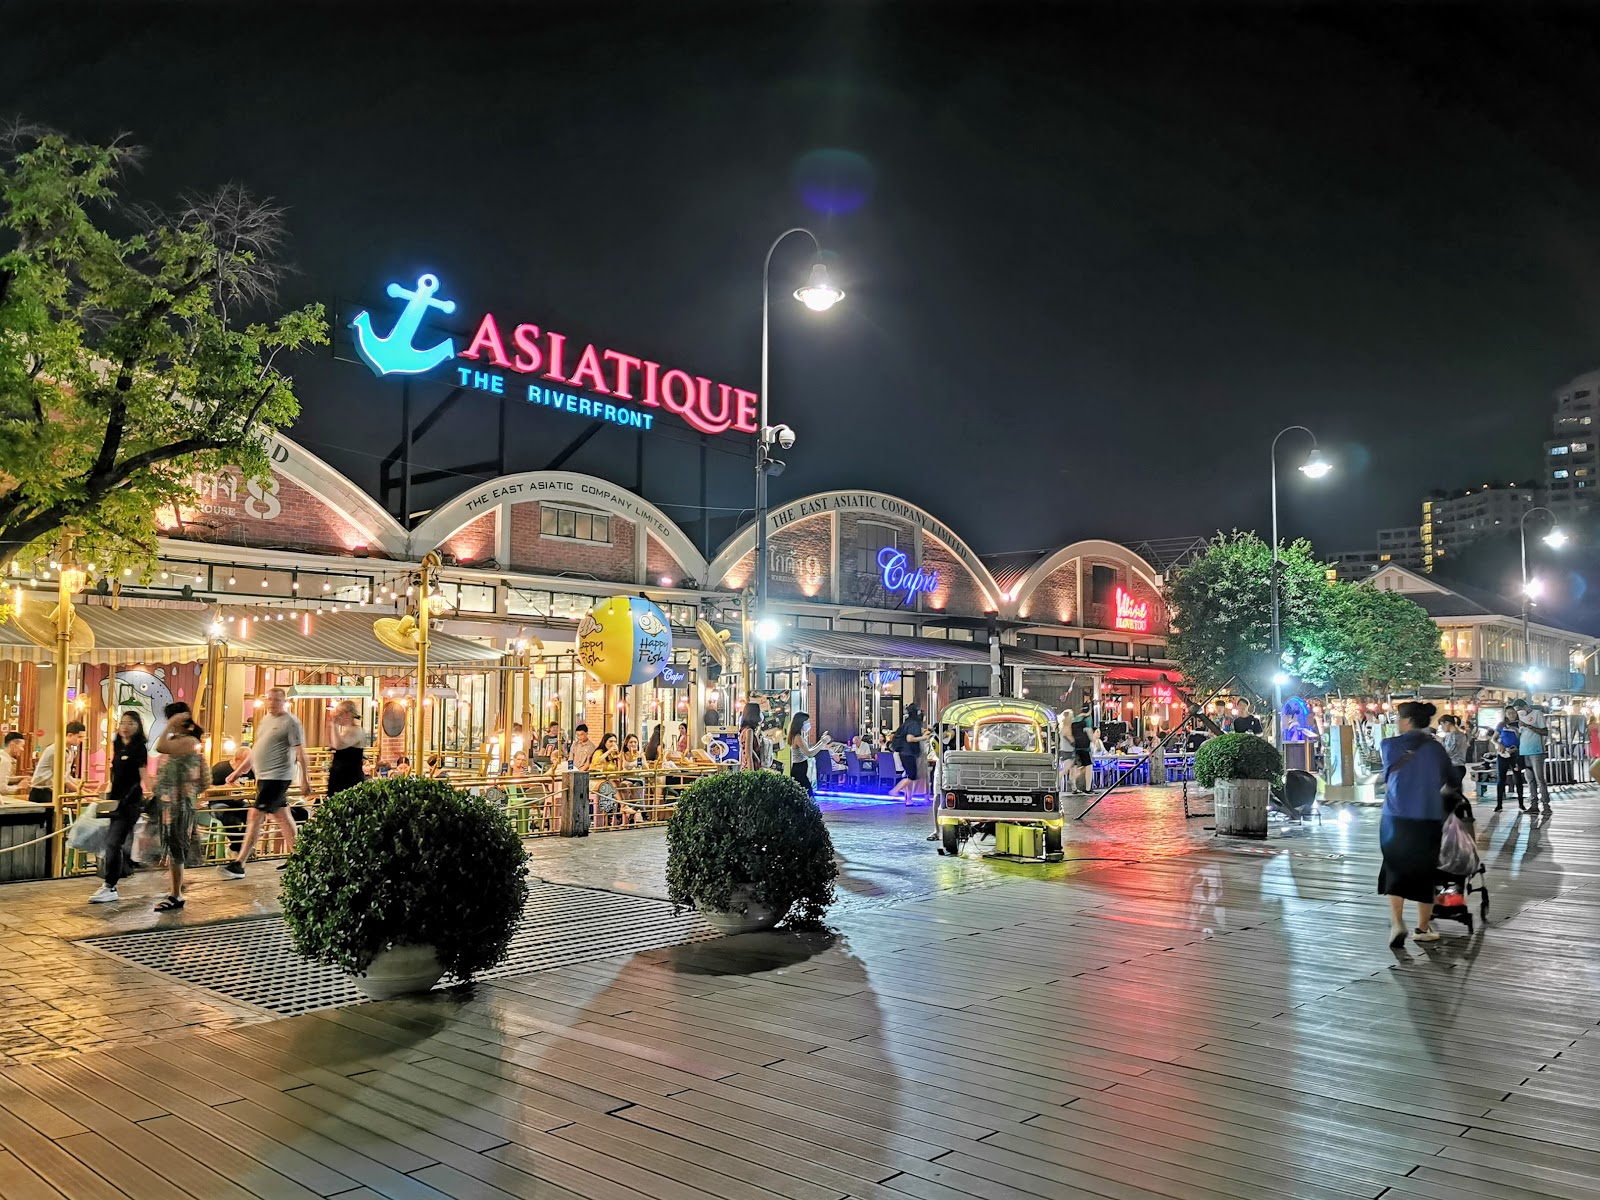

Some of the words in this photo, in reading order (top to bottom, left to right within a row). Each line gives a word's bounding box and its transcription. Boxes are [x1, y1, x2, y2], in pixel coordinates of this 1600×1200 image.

[457, 312, 758, 434] ASIATIQUE
[457, 367, 504, 394] THE
[528, 385, 654, 430] RIVERFRONT
[244, 475, 281, 520] 8
[465, 493, 489, 511] THE
[492, 483, 524, 498] EAST
[529, 481, 574, 491] ASIATIC
[581, 484, 632, 510] COMPANY
[635, 507, 671, 538] LIMITED
[771, 508, 796, 529] THE
[800, 498, 828, 516] EAST
[833, 495, 877, 509] ASIATIC
[881, 498, 928, 527] COMPANY
[931, 522, 967, 559] LIMITED
[877, 547, 938, 604] Capri
[580, 640, 604, 652] appy
[638, 649, 665, 665] Fish
[640, 637, 669, 652] Happy
[966, 794, 1033, 805] THAILAND
